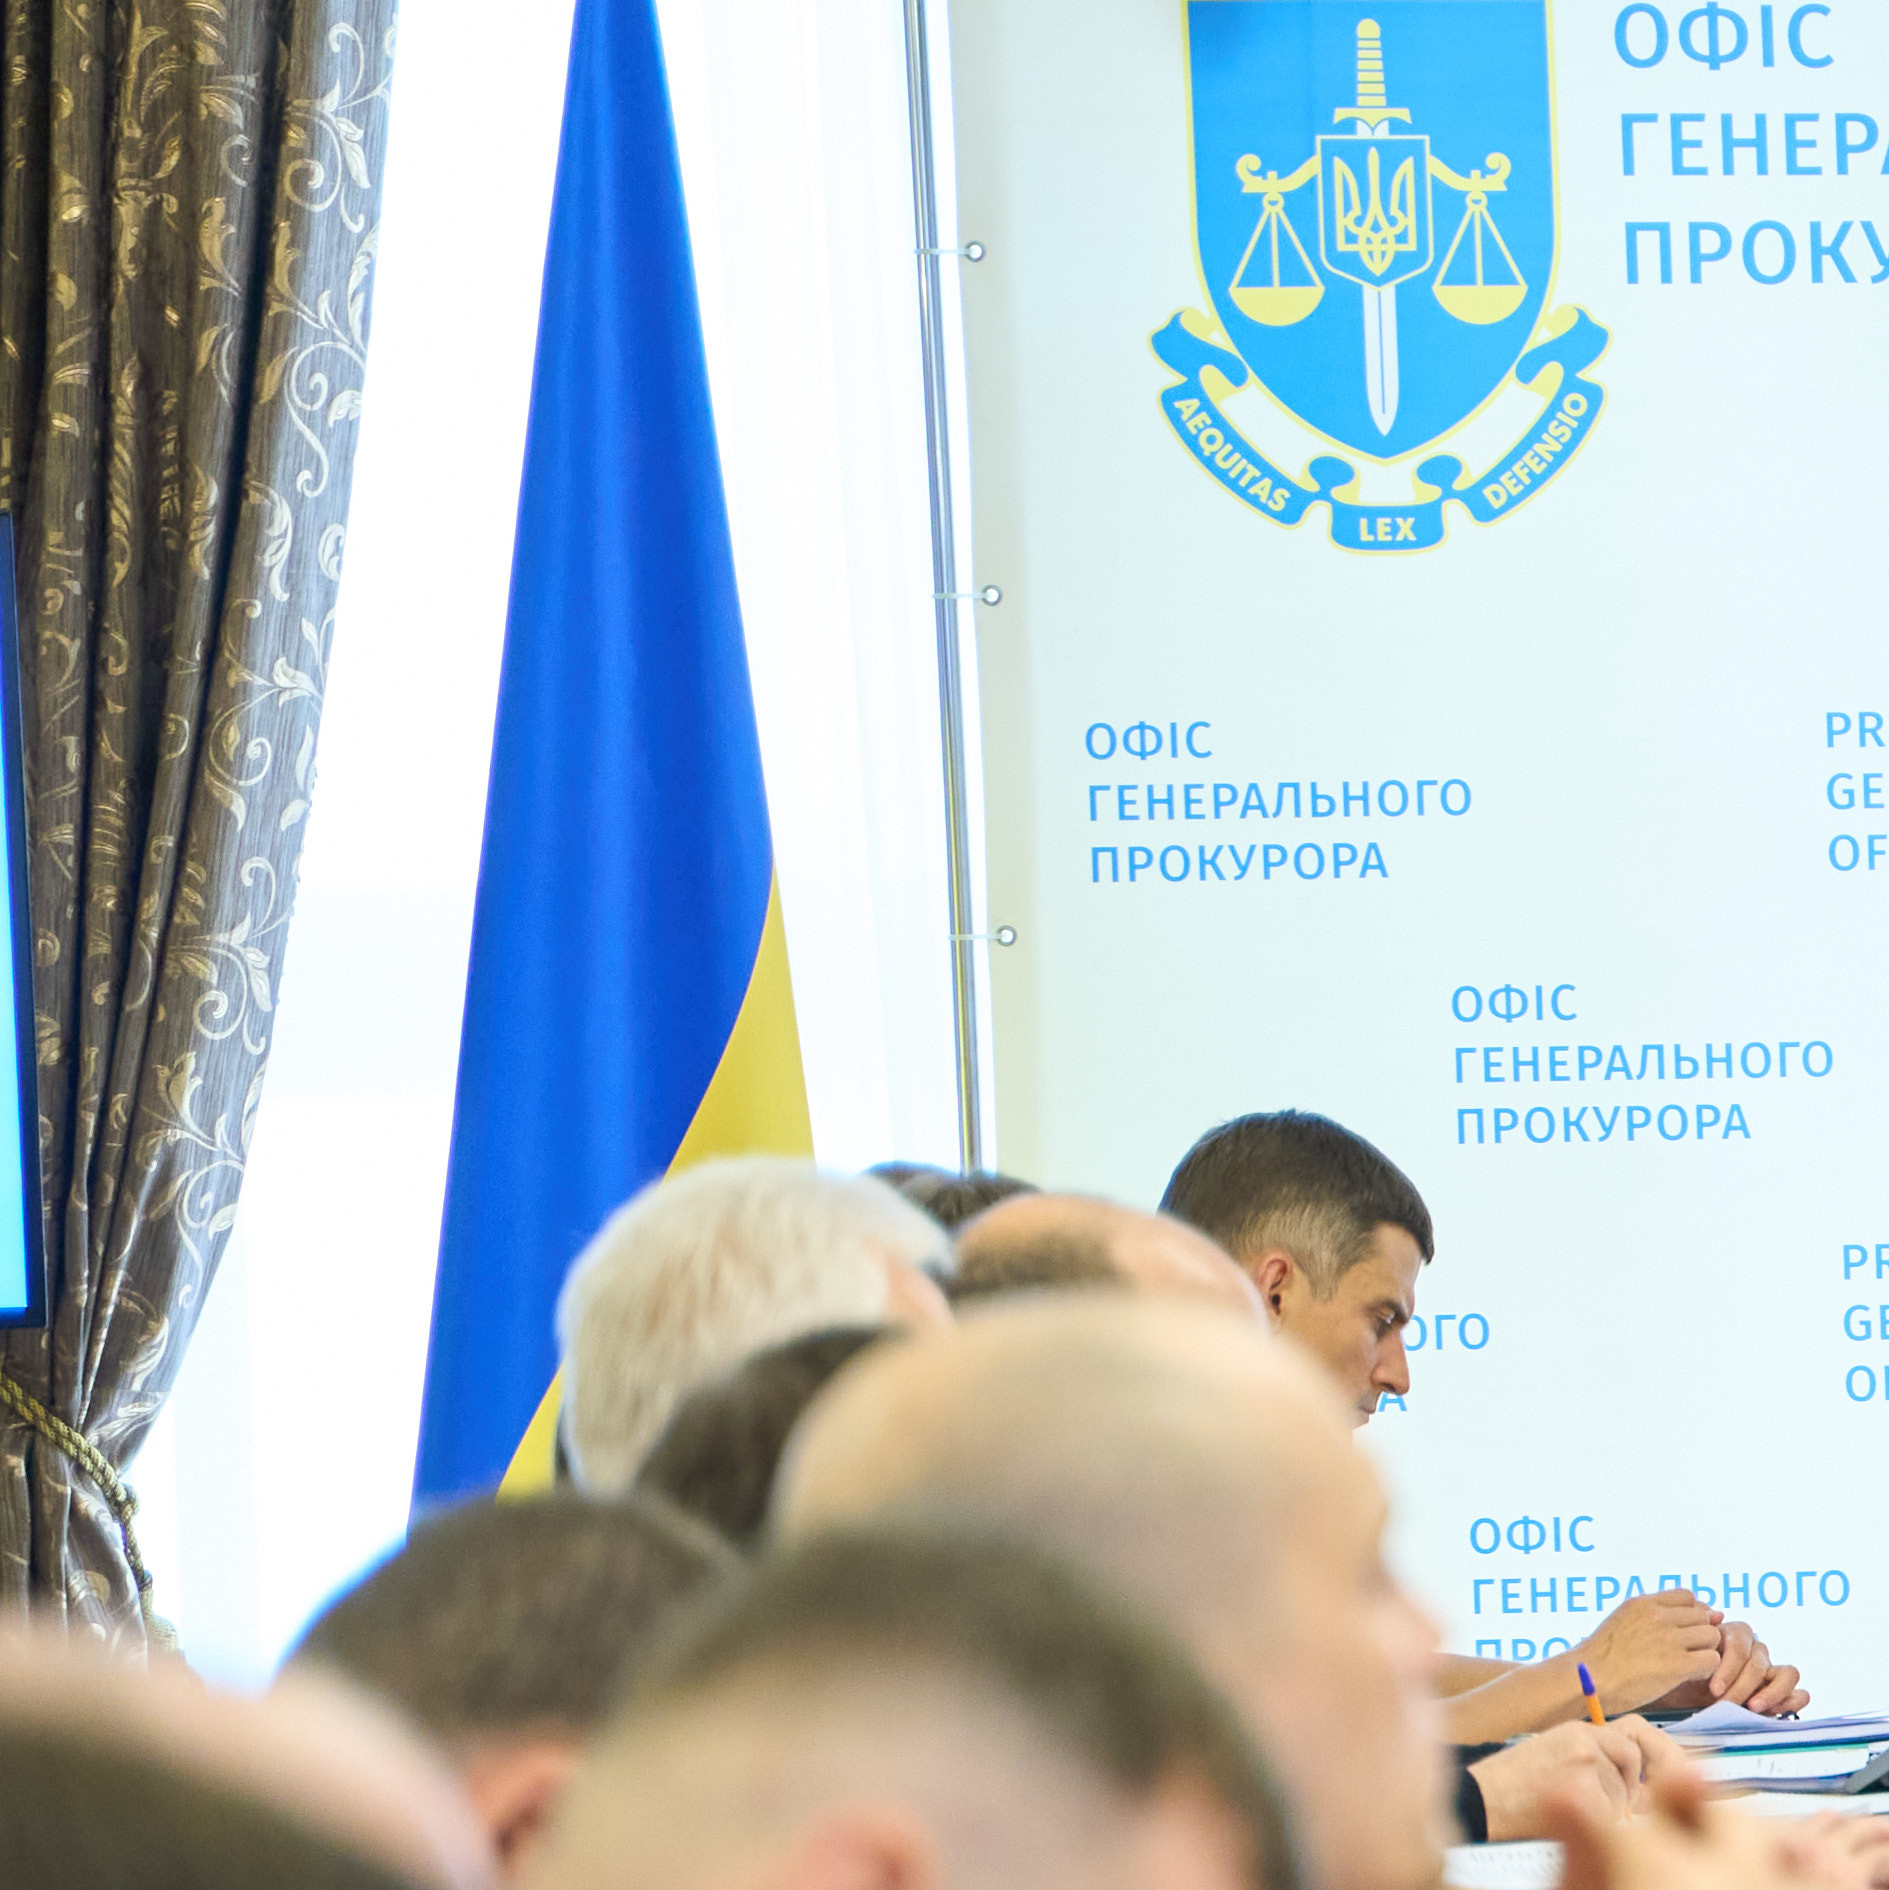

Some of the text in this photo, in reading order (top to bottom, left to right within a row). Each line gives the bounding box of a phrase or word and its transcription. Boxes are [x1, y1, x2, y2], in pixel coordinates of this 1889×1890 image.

[1612, 0, 1835, 72] ОФІС
[1174, 398, 1291, 512] AEQUITAS
[1482, 392, 1589, 510] DEFENSIO
[1359, 517, 1418, 542] LEX
[1083, 719, 1213, 762] ОФІС
[1087, 777, 1473, 822] ГЕНЕРАЛЬНОГО
[1090, 841, 1389, 884] ПРОКУРОРА
[1450, 982, 1578, 1024] ОФІС
[1454, 1039, 1834, 1084] ГЕНЕРАЛЬНОГО
[1456, 1102, 1752, 1145] ПРОКУРОРА
[1468, 1514, 1596, 1555] ОФІС
